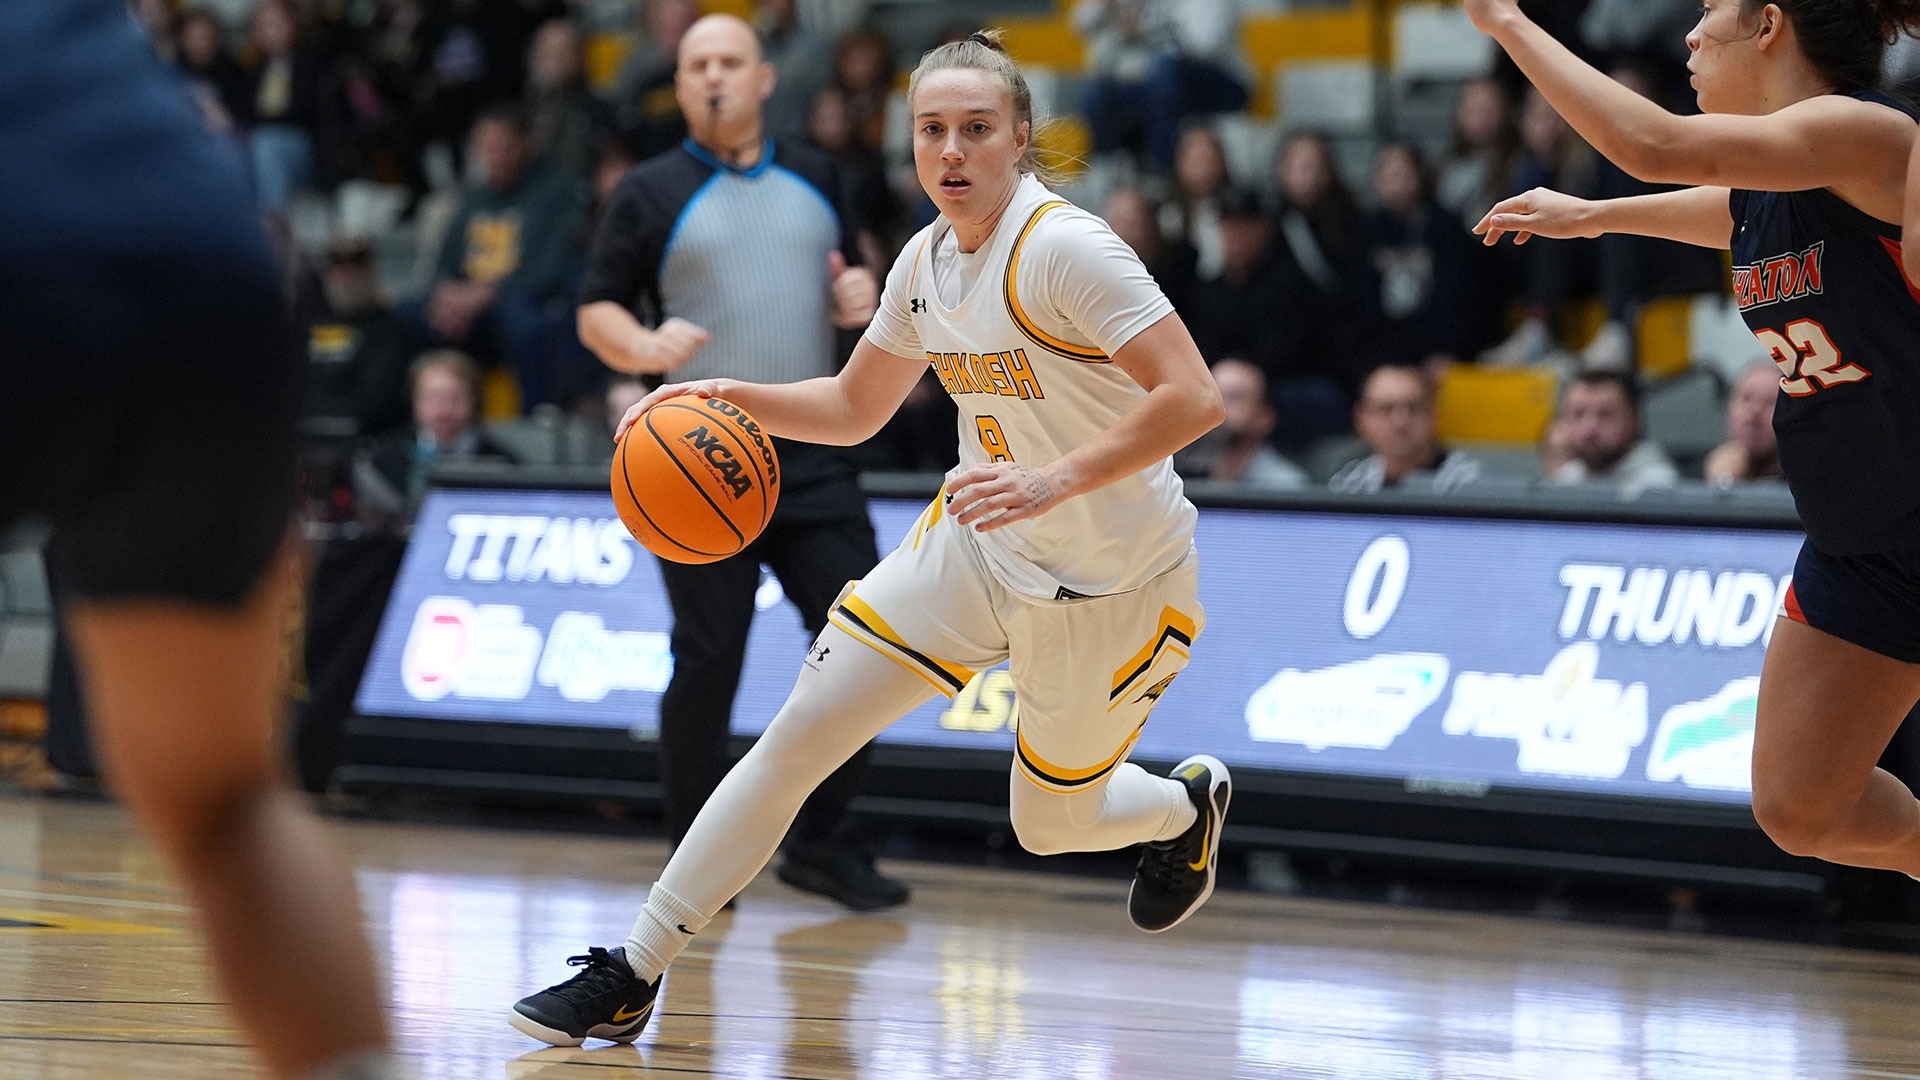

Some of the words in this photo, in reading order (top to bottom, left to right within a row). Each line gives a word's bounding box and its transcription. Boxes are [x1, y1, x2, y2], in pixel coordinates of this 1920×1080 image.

[1754, 318, 1872, 397] 22
[684, 425, 752, 500] NCAA
[706, 398, 777, 489] Wilson
[444, 514, 634, 585] TITANS
[1343, 534, 1410, 640] 0
